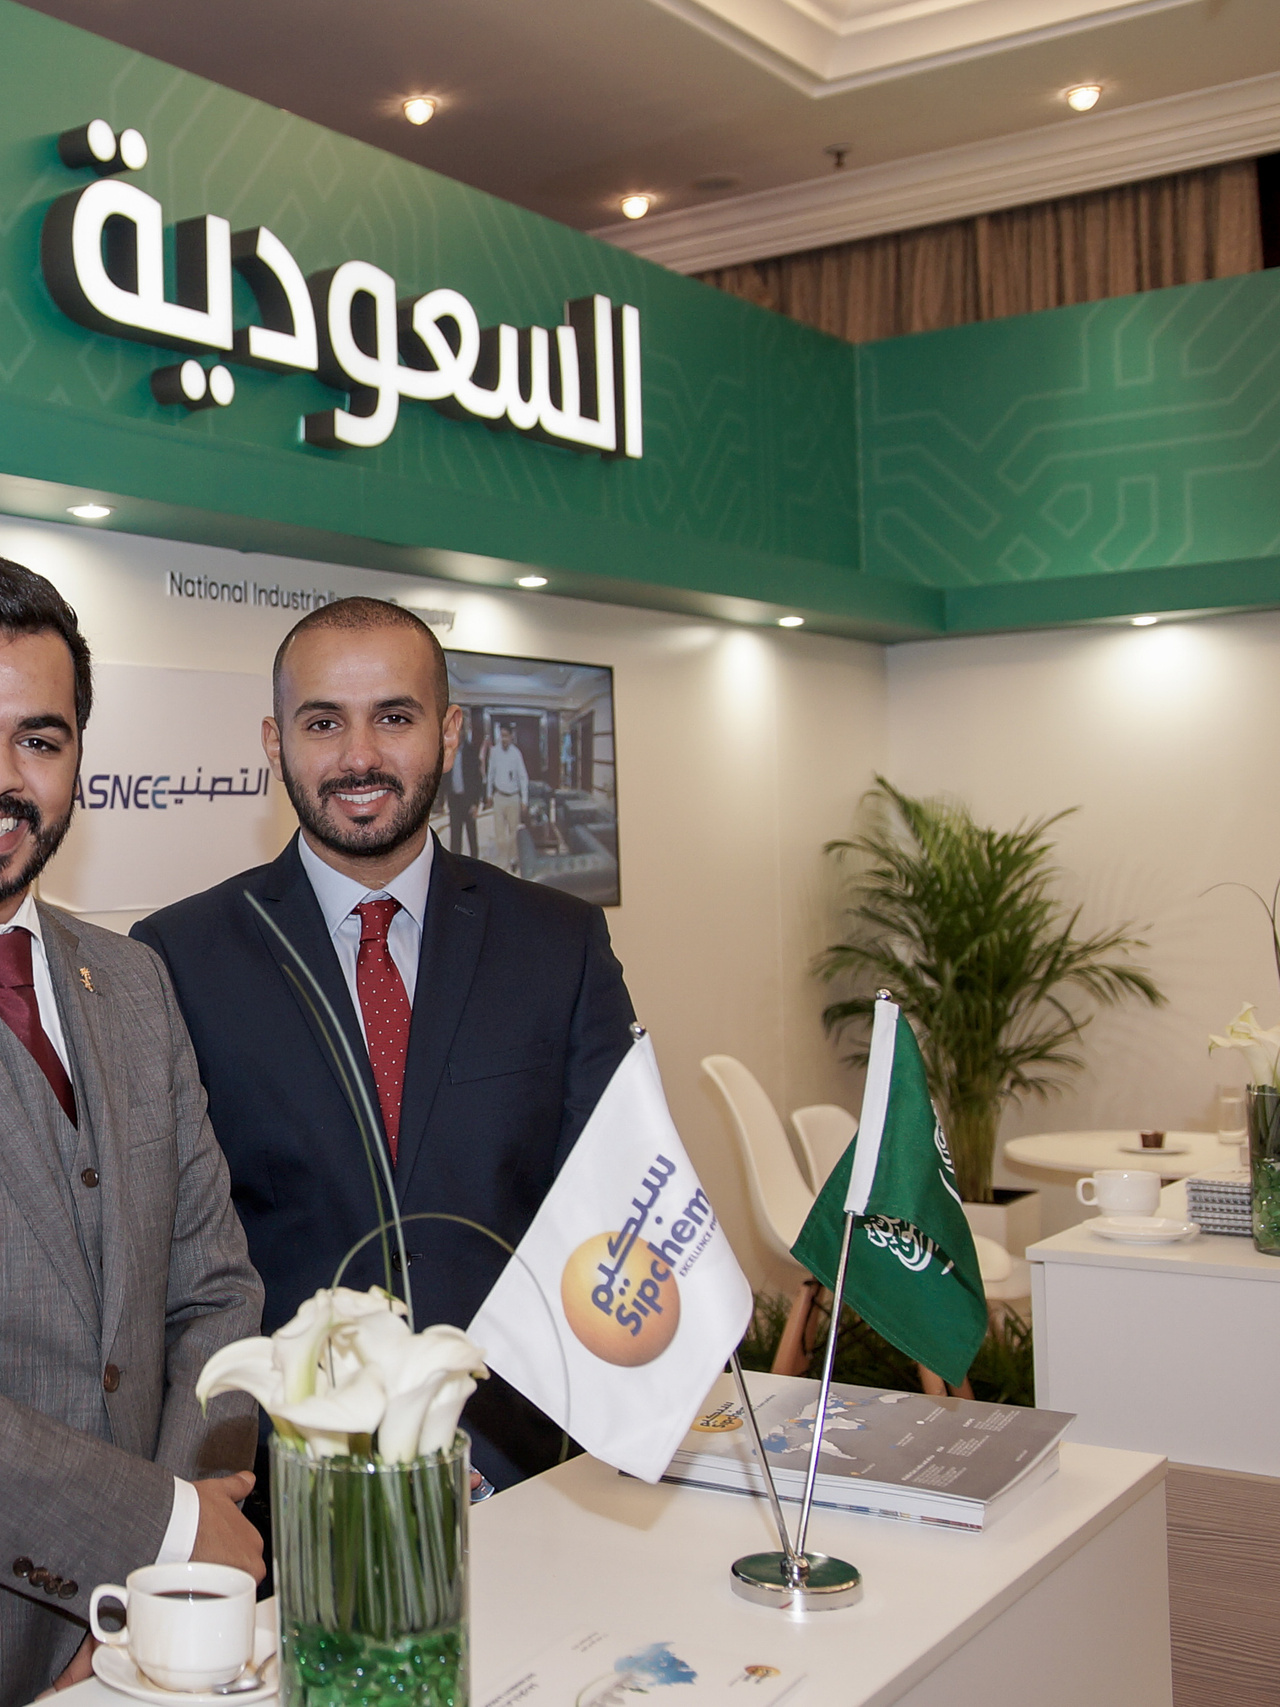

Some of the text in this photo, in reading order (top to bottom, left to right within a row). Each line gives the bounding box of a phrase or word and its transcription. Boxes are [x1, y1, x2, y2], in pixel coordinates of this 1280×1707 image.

[70, 117, 643, 460] السعودية
[170, 571, 340, 611] National Industrial
[75, 774, 170, 809] ASNEE
[591, 1154, 676, 1317] سبكيم
[616, 1187, 711, 1337] Sipchem
[679, 1230, 712, 1278] EXCELLENCE
